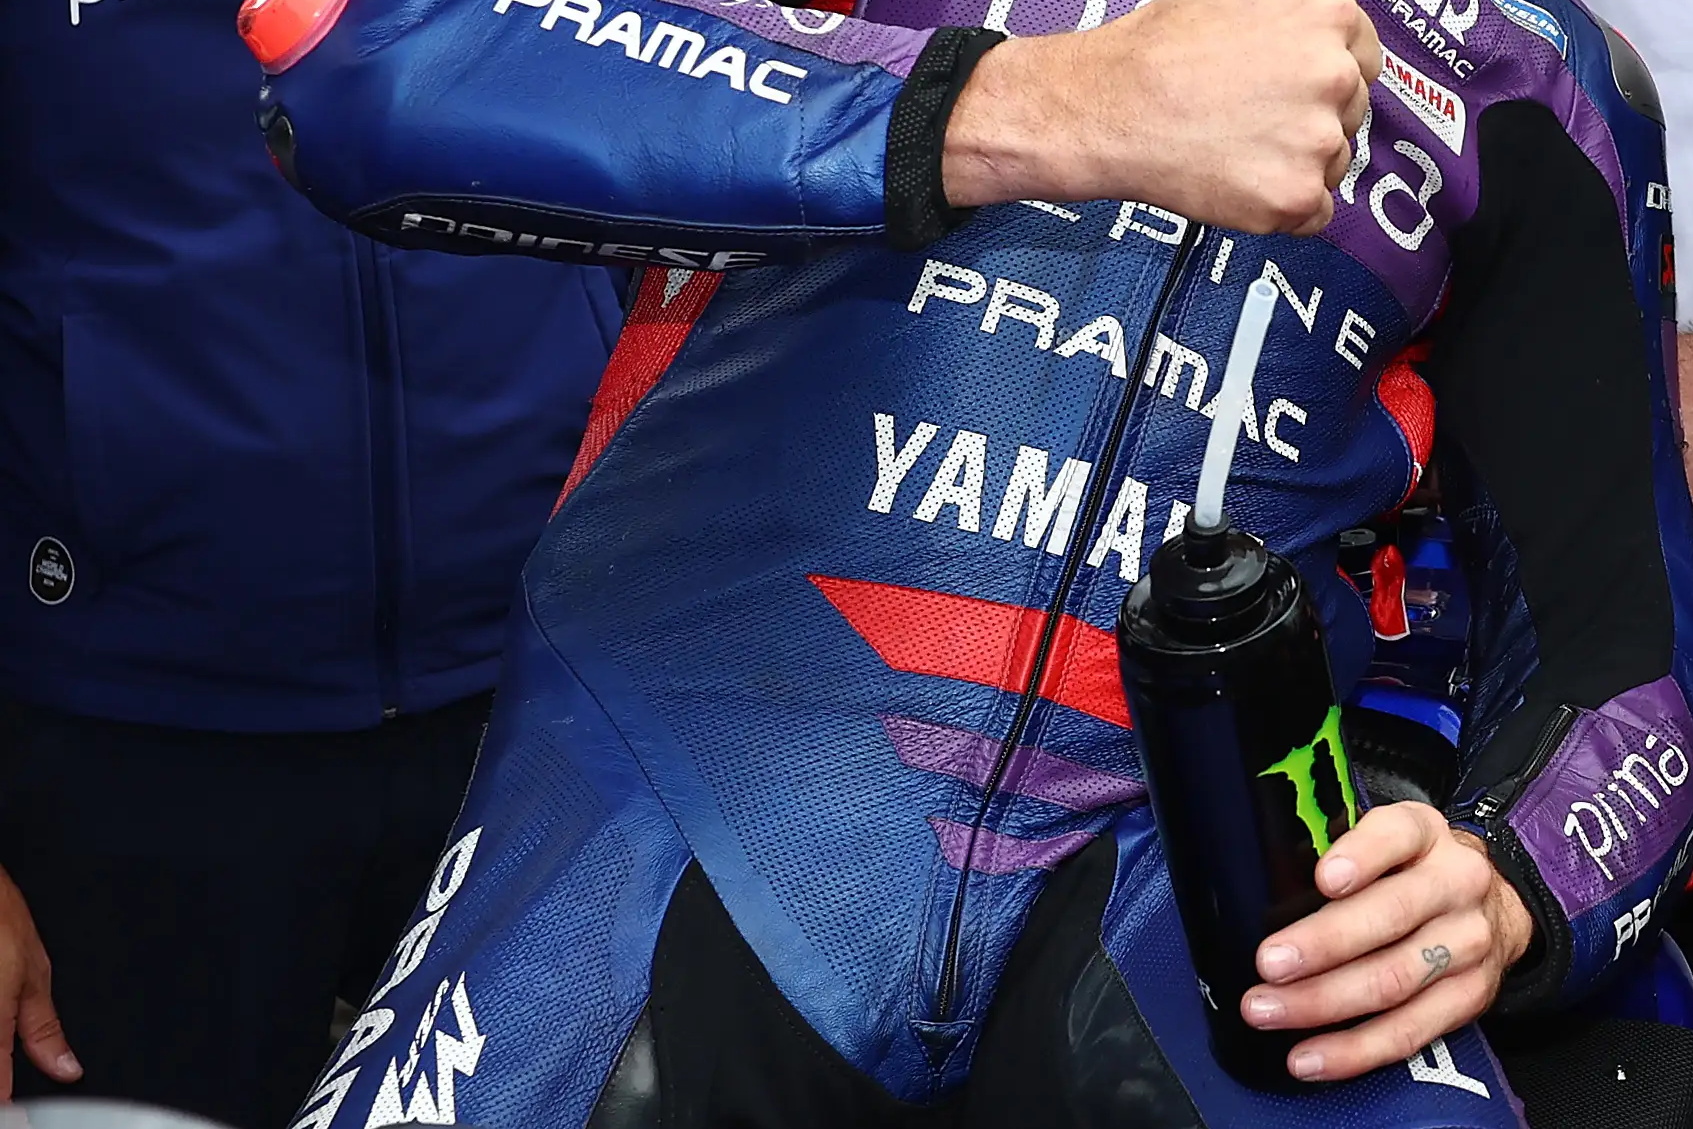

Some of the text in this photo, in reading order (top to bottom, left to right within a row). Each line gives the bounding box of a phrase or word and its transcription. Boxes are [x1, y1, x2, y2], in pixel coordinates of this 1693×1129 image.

[1385, 55, 1456, 123] AMAHA
[867, 412, 1195, 583] YAMA
[1563, 734, 1690, 881] prima
